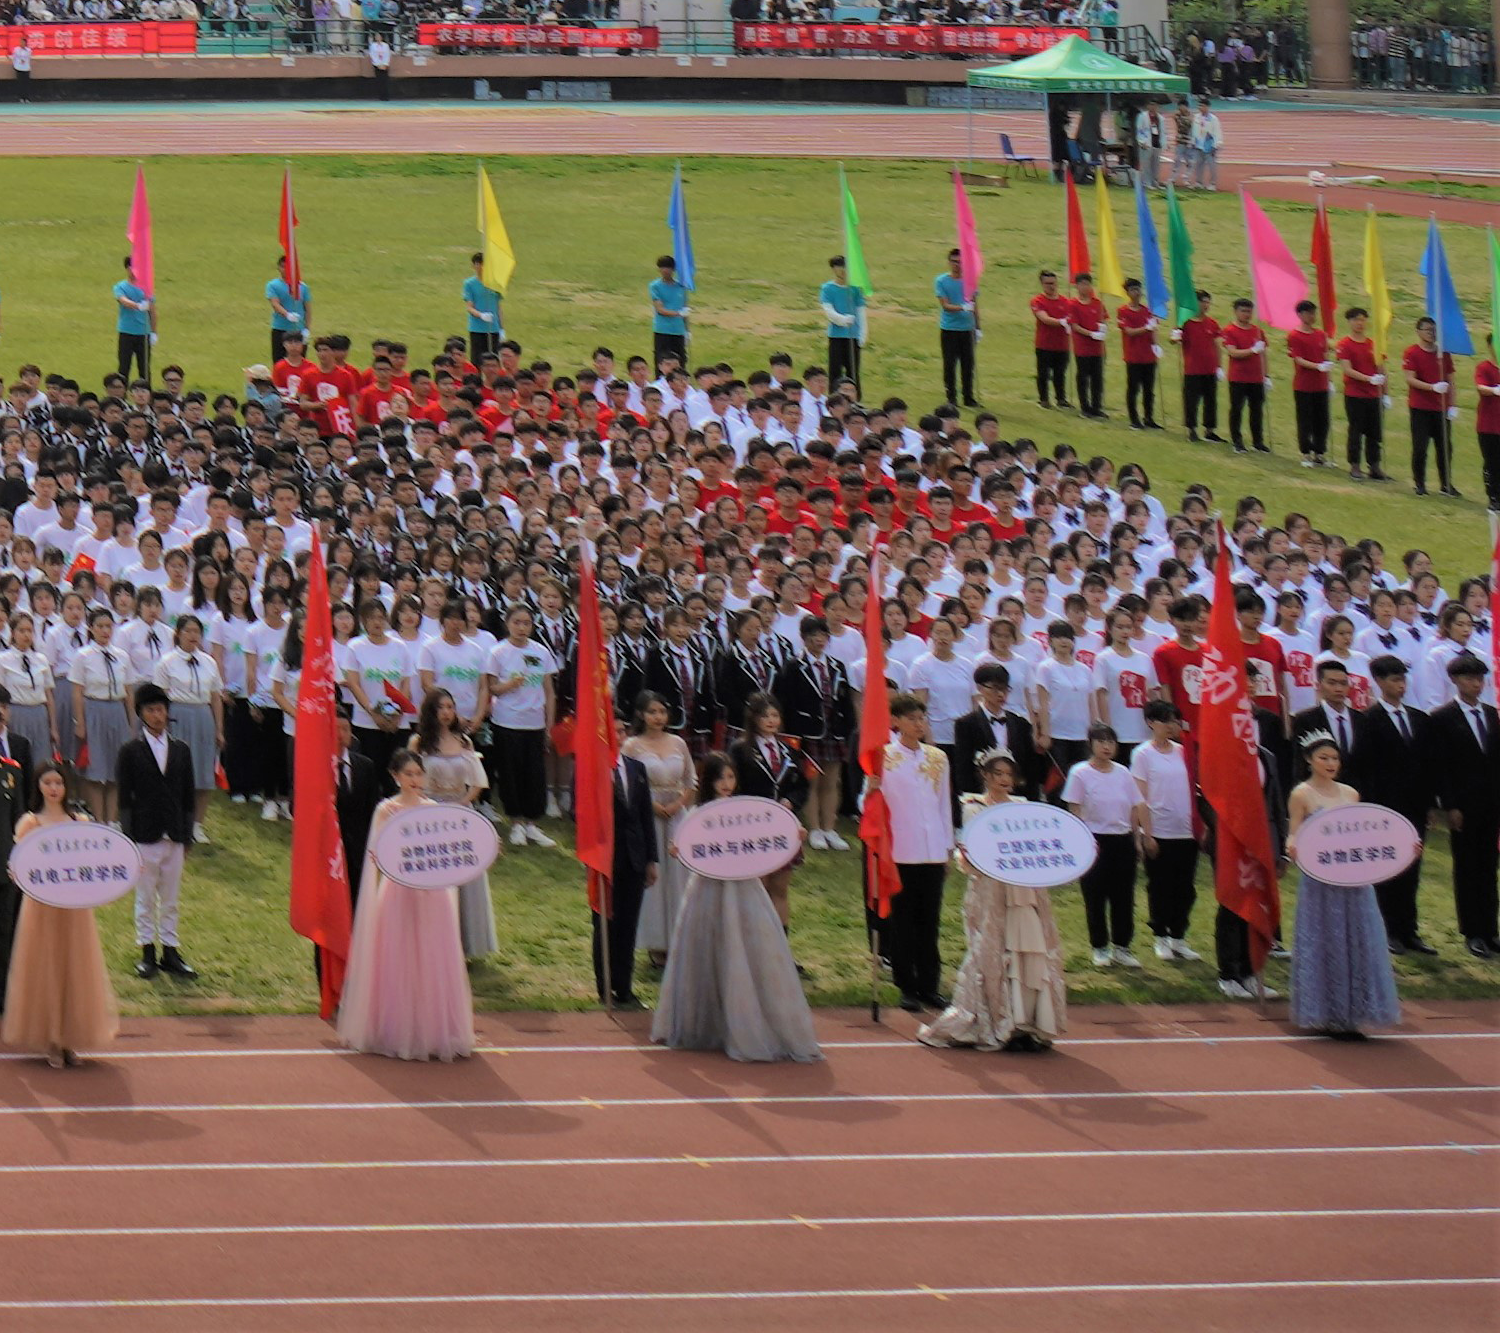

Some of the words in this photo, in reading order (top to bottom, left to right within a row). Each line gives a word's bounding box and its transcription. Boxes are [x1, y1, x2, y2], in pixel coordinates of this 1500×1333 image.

[401, 840, 474, 858] 动物科技学院
[691, 835, 789, 859] 园林与林学院
[1316, 845, 1396, 865] 动物医学院
[995, 854, 1077, 871] 农业科技学院
[27, 864, 128, 884] 机电工程学院
